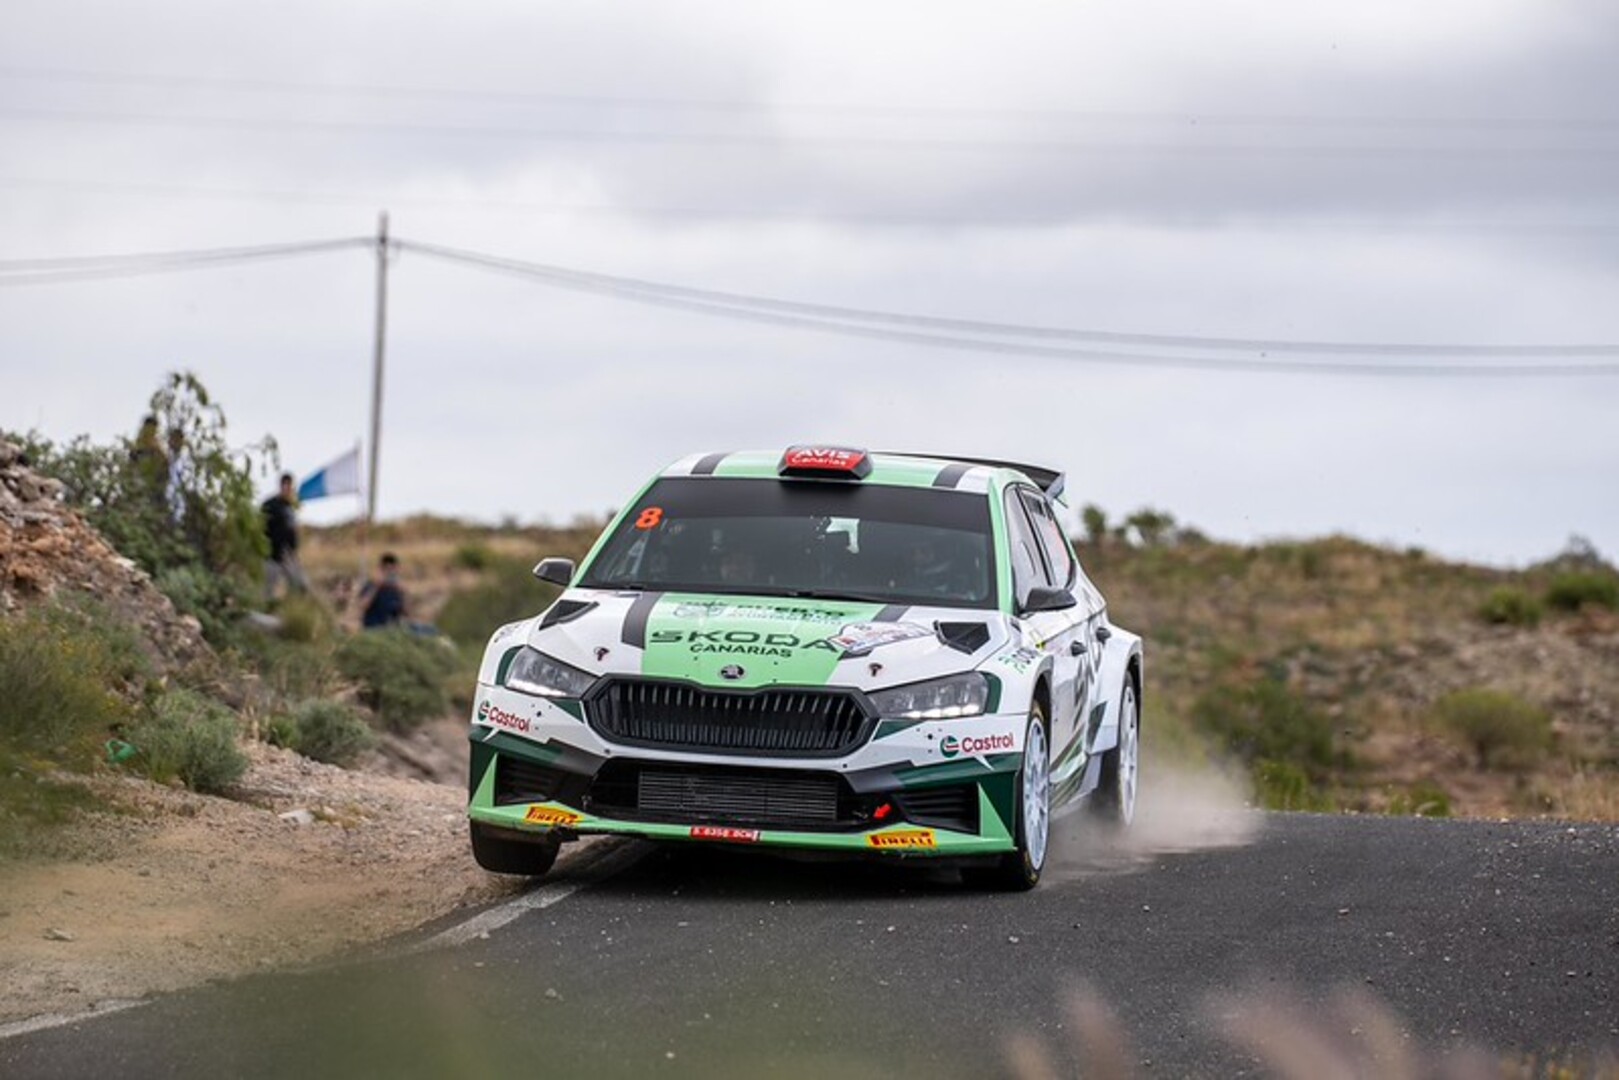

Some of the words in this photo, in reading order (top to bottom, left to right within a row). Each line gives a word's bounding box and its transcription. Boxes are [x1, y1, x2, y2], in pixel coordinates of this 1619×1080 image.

[791, 457, 847, 467] Canarias
[795, 448, 851, 459] AVIS
[635, 506, 663, 529] 8
[690, 643, 793, 658] CANARIAS
[489, 706, 532, 732] Castrol
[961, 732, 1014, 753] Castrol
[526, 806, 578, 824] PIRELLI
[869, 831, 934, 849] PIRELLI
